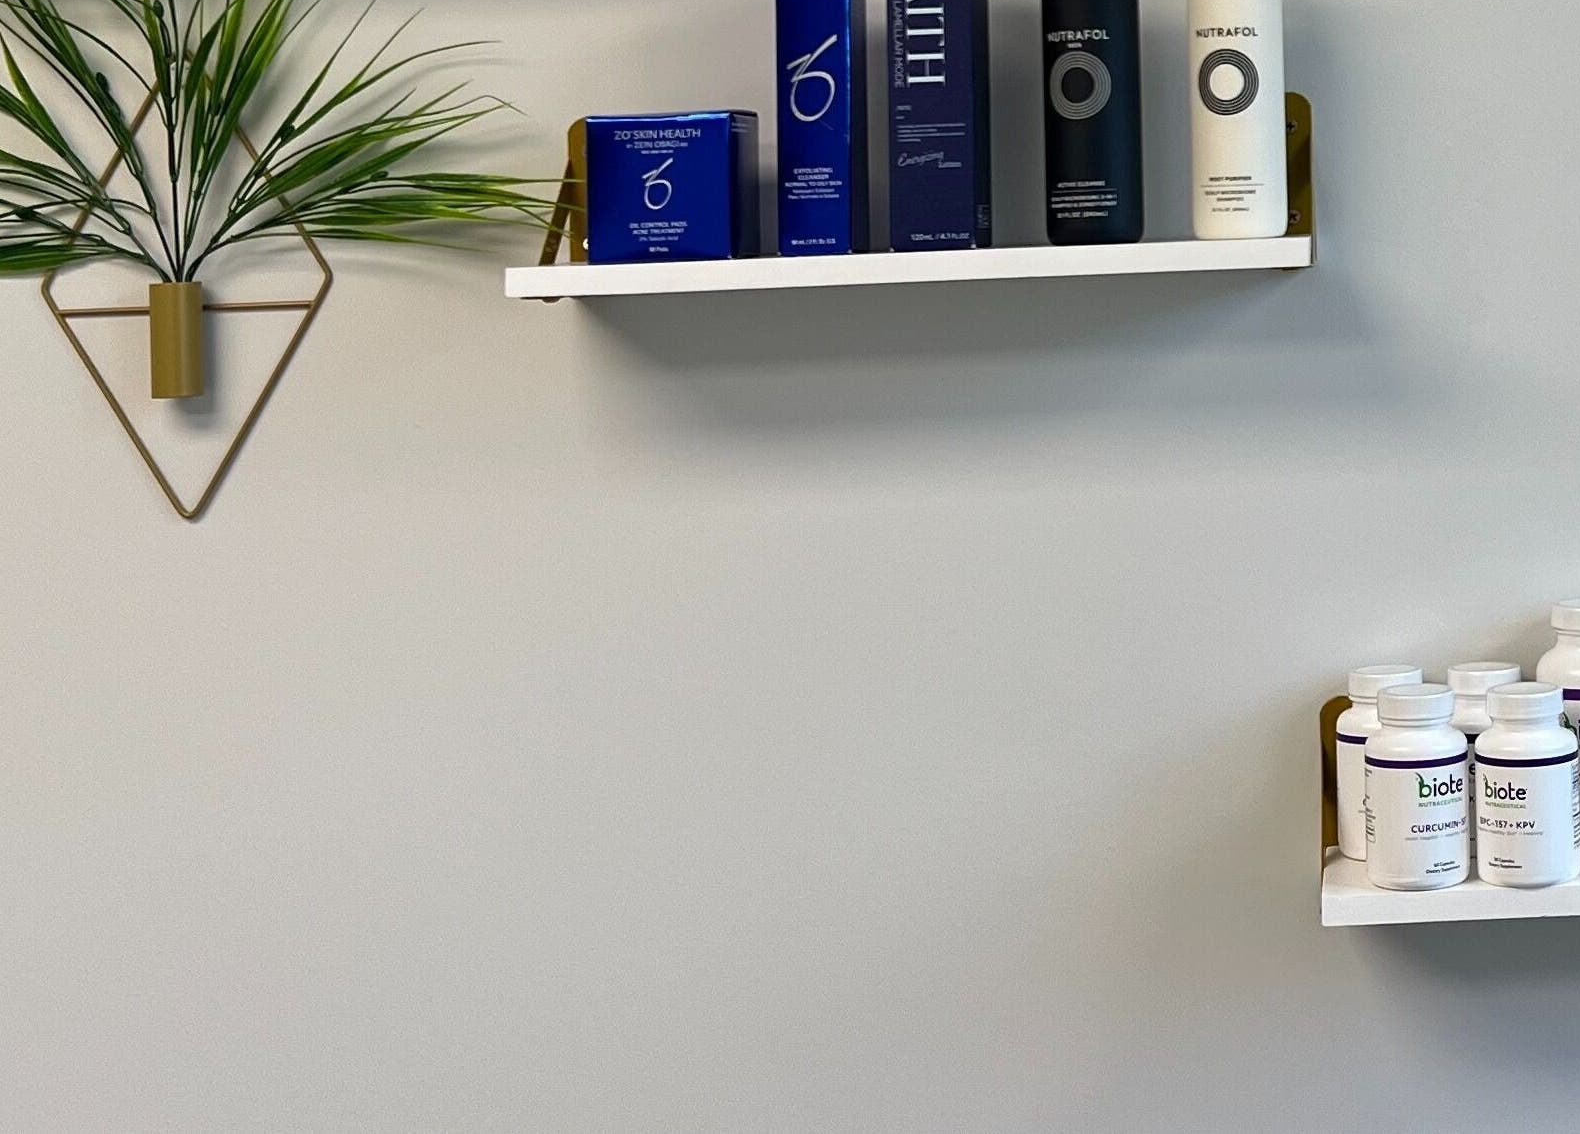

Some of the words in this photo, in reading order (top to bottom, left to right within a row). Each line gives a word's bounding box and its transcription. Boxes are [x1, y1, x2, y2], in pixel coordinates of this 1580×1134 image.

[1047, 28, 1111, 44] NUTRAFOL
[1195, 26, 1259, 39] NUTRAFOL
[632, 128, 658, 140] SKIN
[660, 127, 701, 140] HEALTH
[1414, 771, 1464, 799] biote
[1482, 773, 1527, 801] biote
[1516, 820, 1536, 830] KPV
